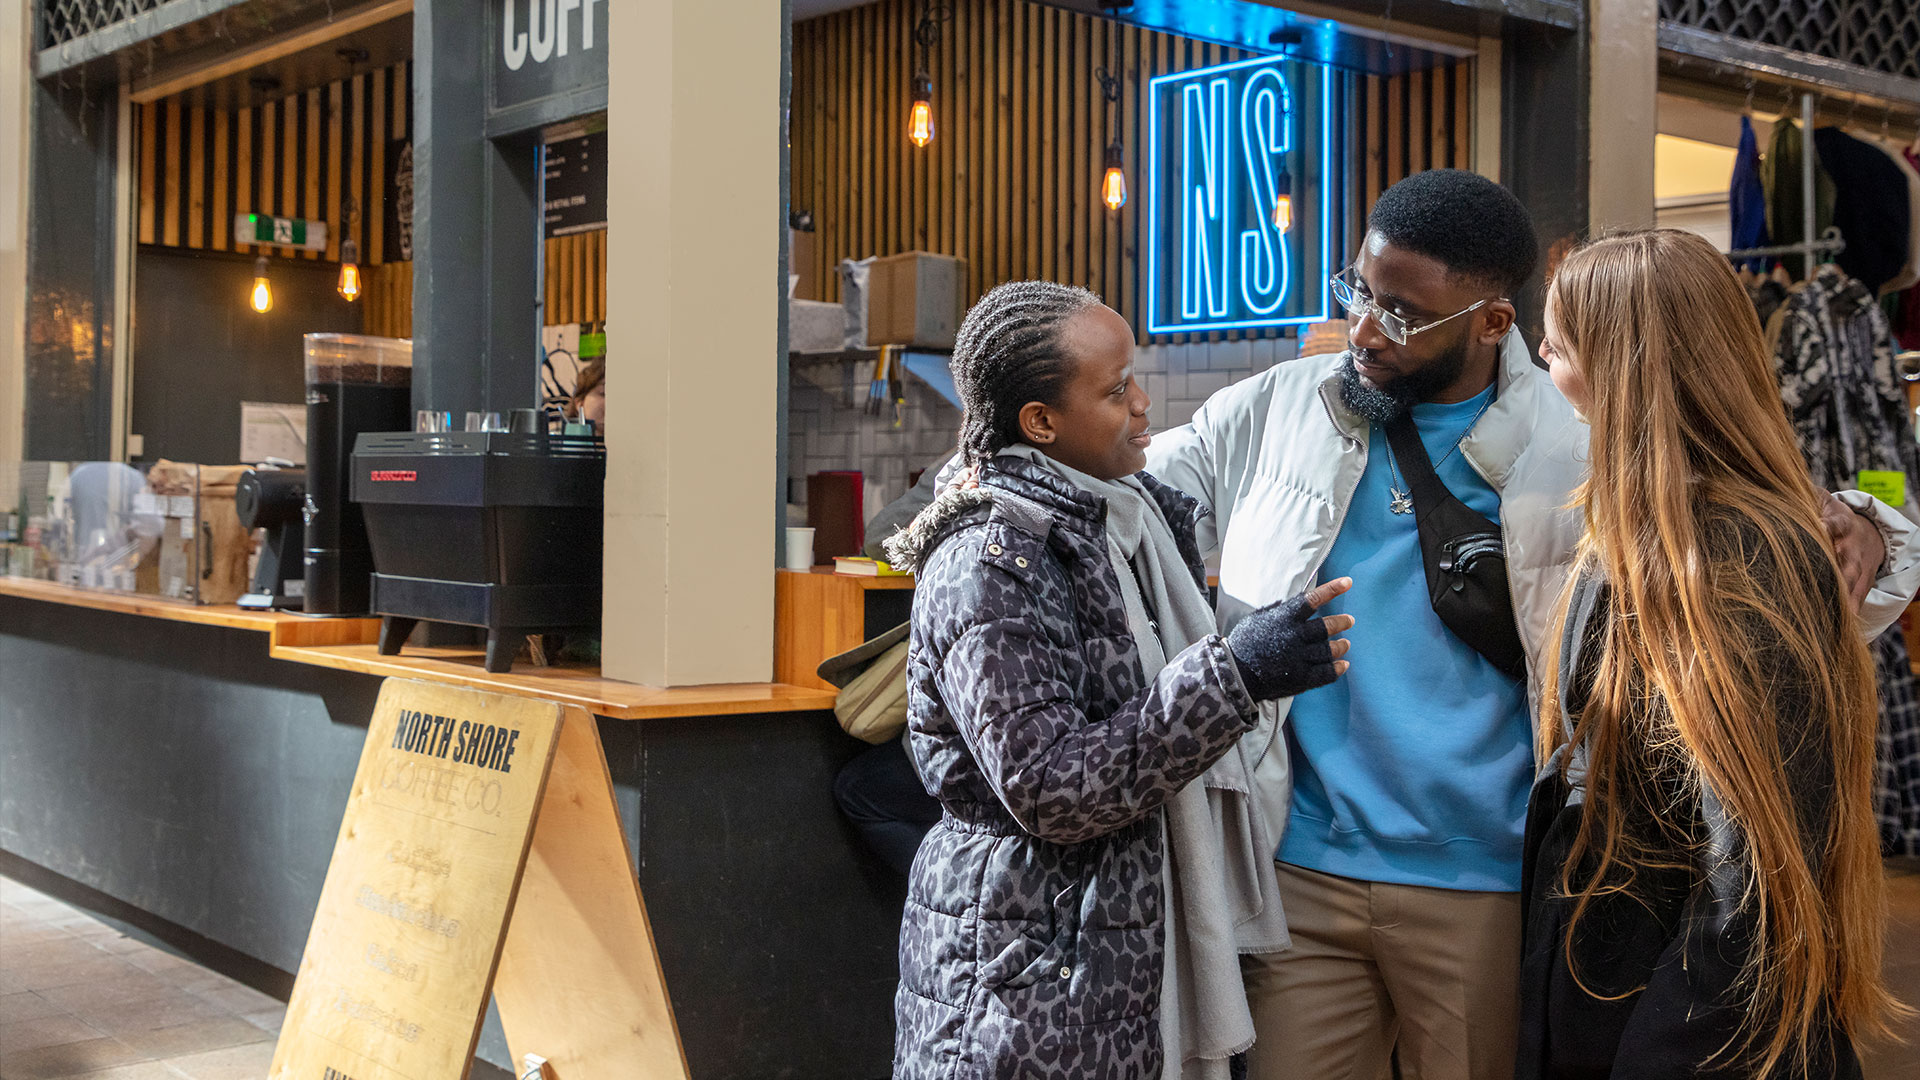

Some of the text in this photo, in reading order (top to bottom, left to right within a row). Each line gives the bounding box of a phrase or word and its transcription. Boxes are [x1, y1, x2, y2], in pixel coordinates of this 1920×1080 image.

[1182, 67, 1290, 318] NS
[392, 709, 520, 773] NORTH SHORE
[381, 757, 502, 818] COFFEE CO.
